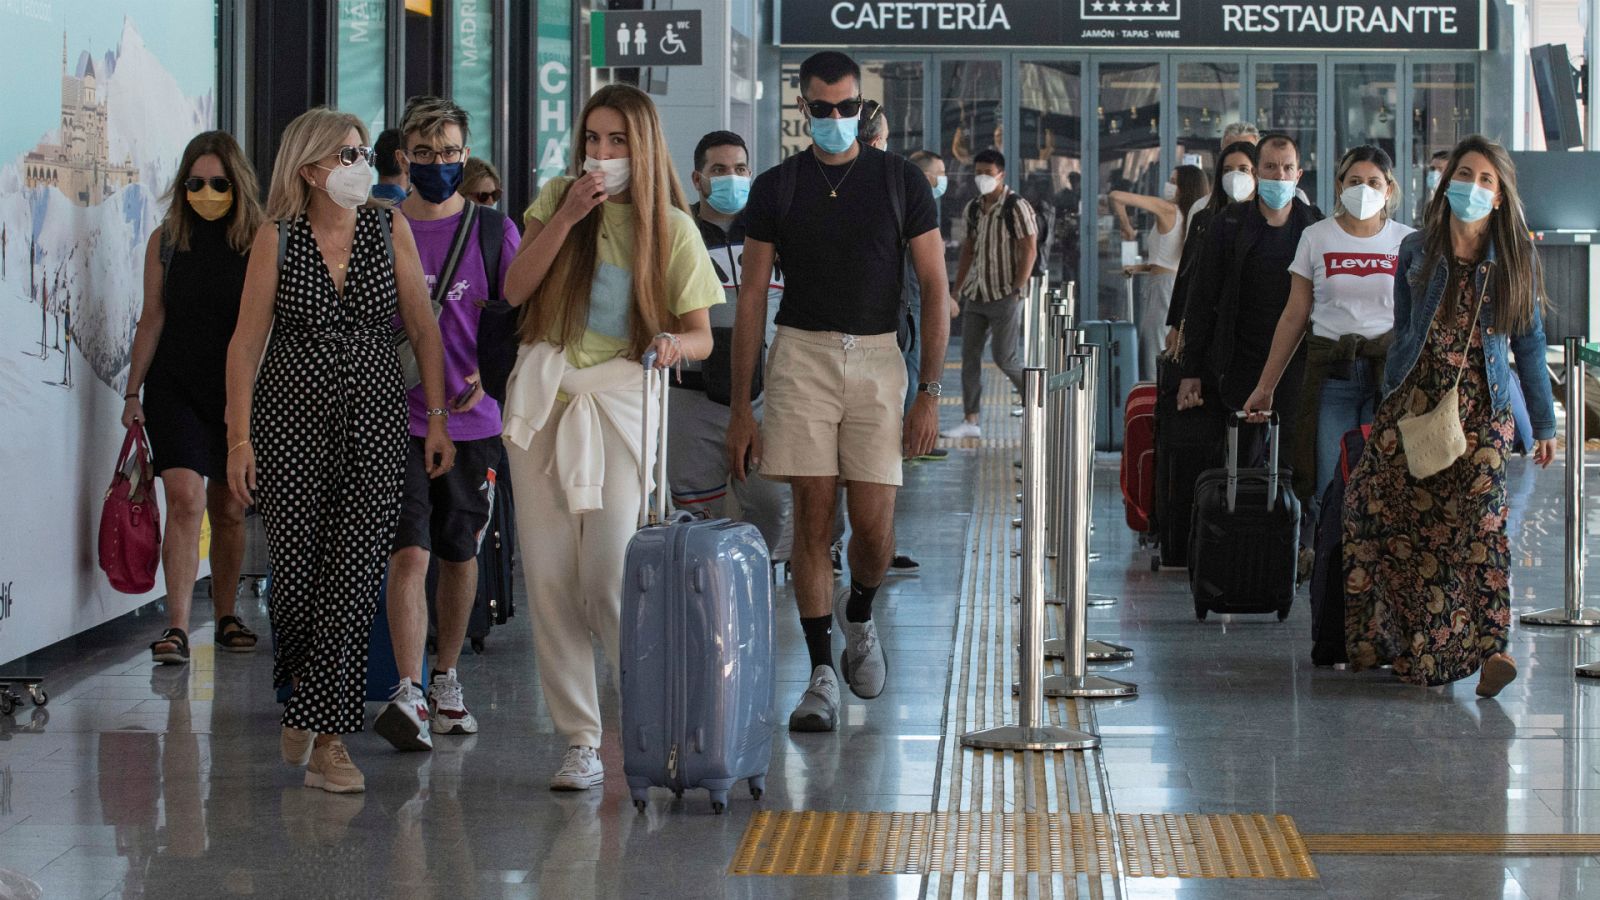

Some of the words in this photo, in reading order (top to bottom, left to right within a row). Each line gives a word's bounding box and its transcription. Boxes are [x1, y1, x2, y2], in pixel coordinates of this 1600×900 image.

[676, 21, 690, 29] WC
[830, 0, 1011, 30] CAFETERÍA
[1222, 5, 1458, 34] RESTAURANTE
[1081, 28, 1115, 38] JAMÓN
[1121, 29, 1149, 38] TAPAS
[1155, 30, 1180, 39] WINE
